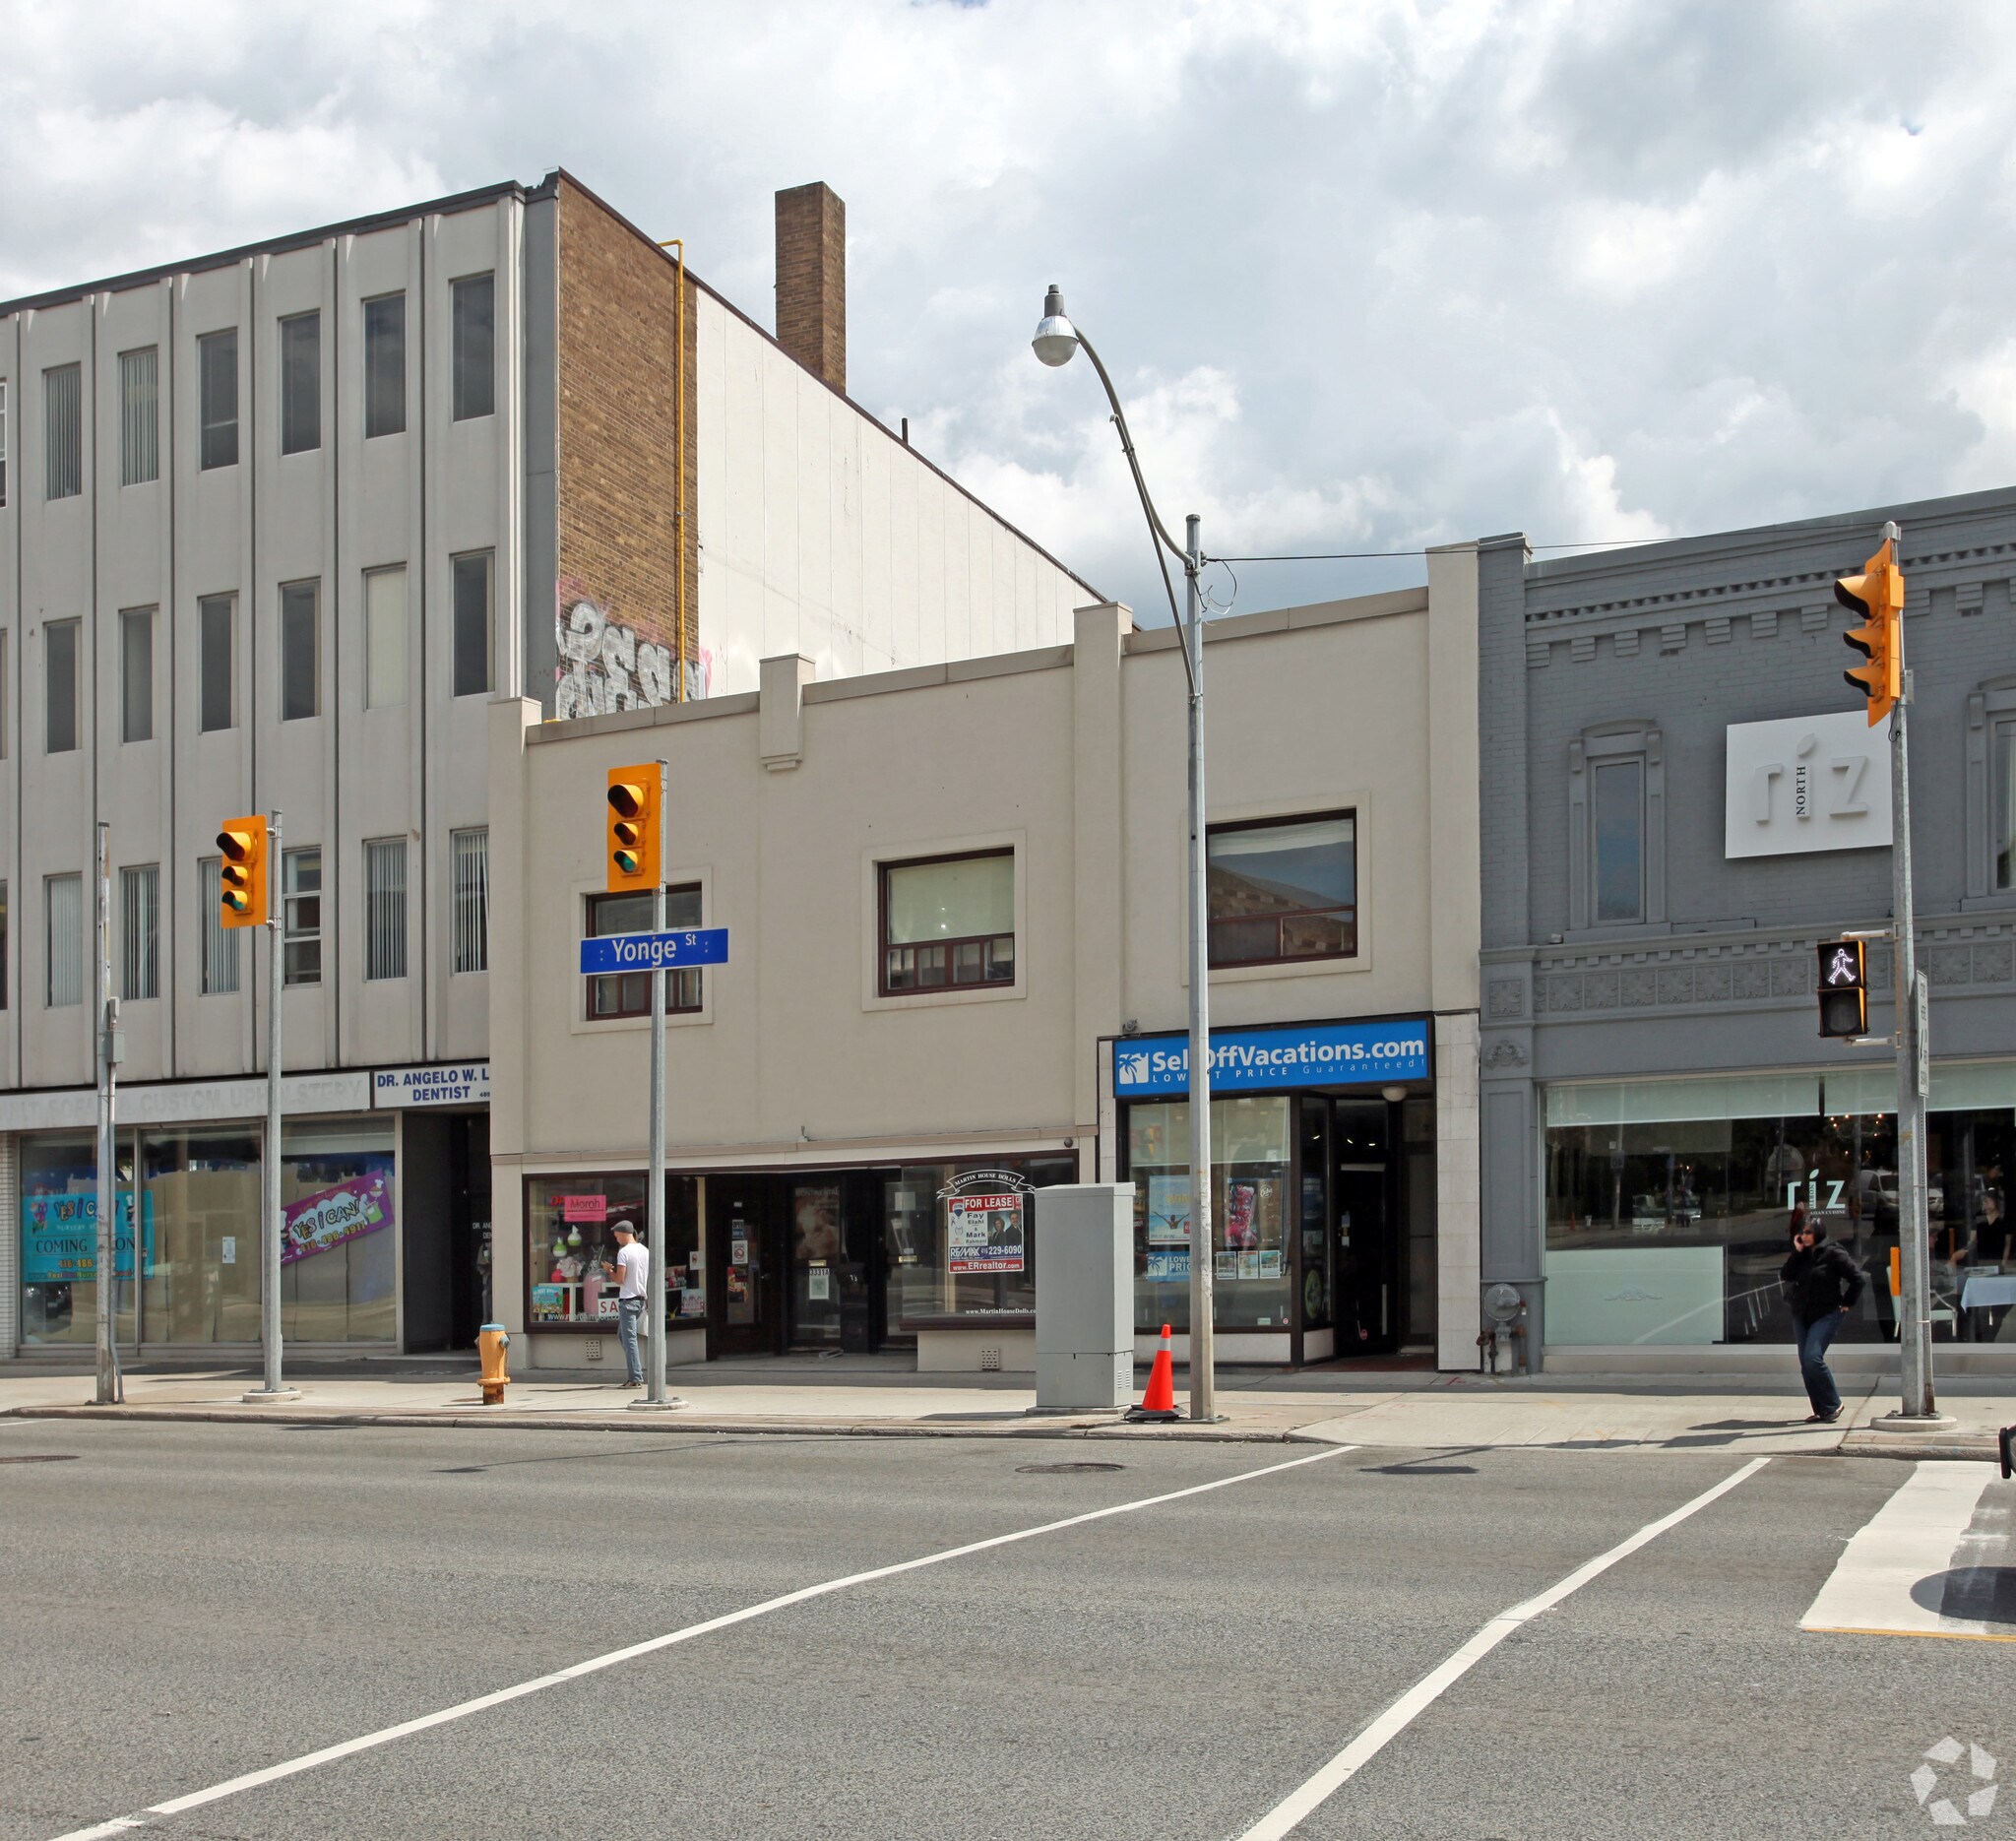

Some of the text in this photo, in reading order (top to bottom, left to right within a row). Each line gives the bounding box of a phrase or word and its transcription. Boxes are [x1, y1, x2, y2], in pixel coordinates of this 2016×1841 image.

[1796, 765, 1806, 815] NORTH
[611, 933, 697, 966] Yonge St
[1153, 1040, 1424, 1072] SelffVacations.com
[377, 1075, 399, 1088] DR.
[403, 1070, 458, 1086] ANGELO
[462, 1069, 477, 1082] W.
[1153, 1058, 1424, 1083] LOWT PRICE Guaranteed!
[140, 1089, 221, 1113] CUSTOM
[229, 1080, 363, 1110] UPHLSTERY
[413, 1086, 471, 1102] DENTIST
[954, 1174, 976, 1186] MARTIN
[998, 1174, 1017, 1183] DOLLS
[1788, 1169, 1846, 1211] riz
[53, 1200, 76, 1222] YES
[965, 1198, 982, 1209] FOR
[984, 1196, 1013, 1208] LEASE
[292, 1217, 317, 1240] YES
[35, 1237, 136, 1253] COMING ON
[950, 1246, 980, 1257] RE/MAX
[988, 1245, 1022, 1255] 229-6090
[953, 1261, 1020, 1271] www.ERrealtor.com
